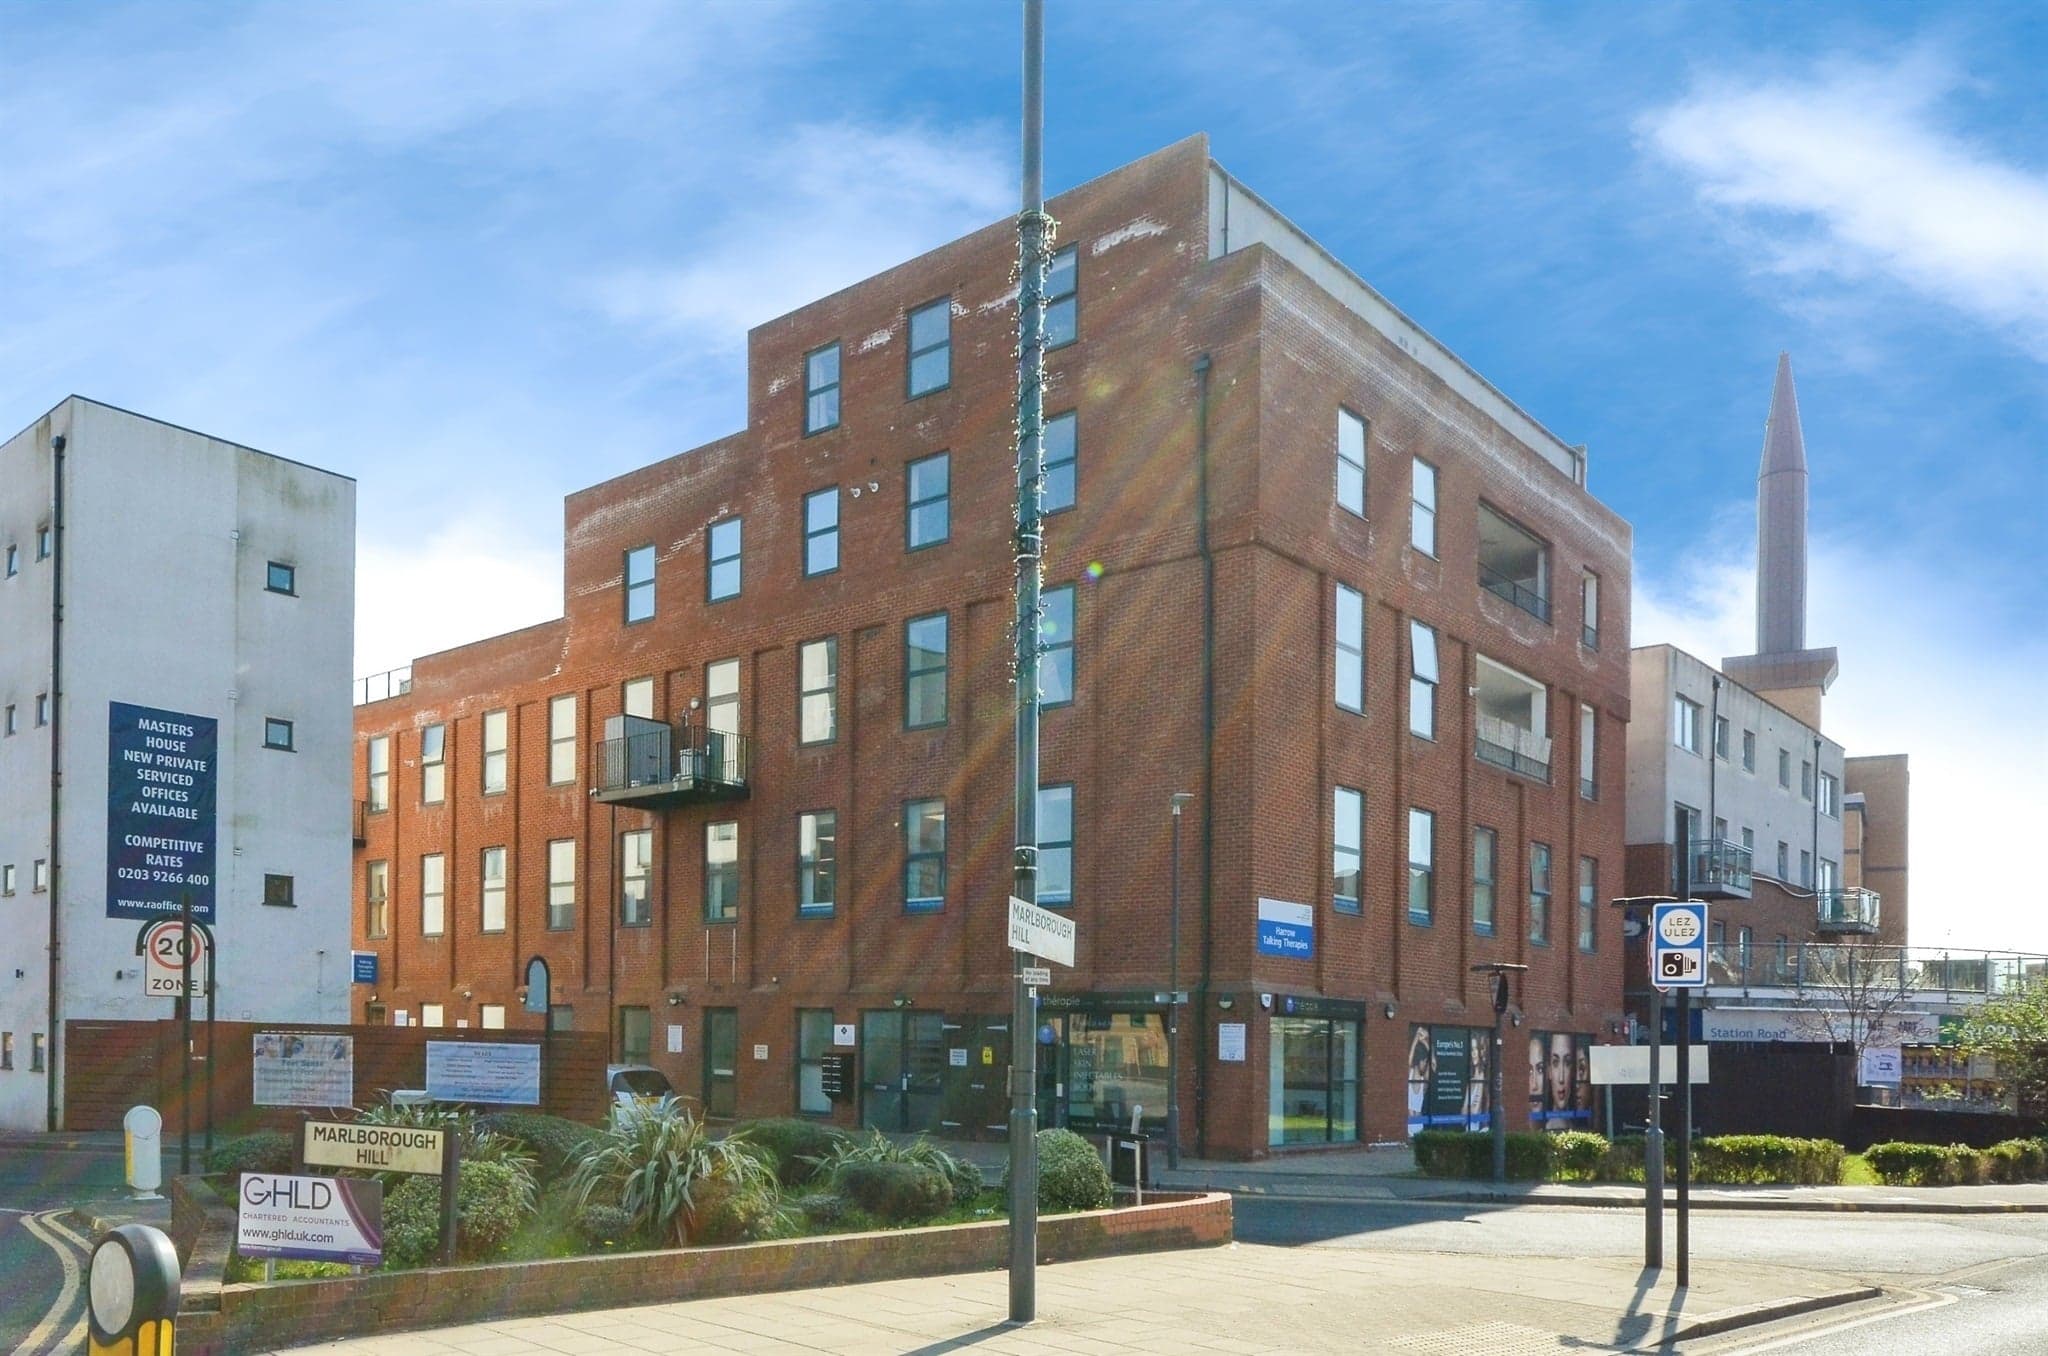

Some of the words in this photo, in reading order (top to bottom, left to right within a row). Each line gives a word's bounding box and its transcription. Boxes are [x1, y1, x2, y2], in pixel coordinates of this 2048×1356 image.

[138, 718, 194, 737] MASTERS
[146, 736, 187, 753] HOUSE
[124, 749, 153, 764] NEW
[156, 754, 207, 772] PRIVATE
[137, 768, 194, 786] SERVICED
[142, 786, 189, 802] OFFICES
[131, 801, 198, 820] AVAILABLE
[125, 834, 204, 853] COMPETITIVE
[146, 853, 183, 868] RATES
[118, 867, 149, 880] 0203
[153, 870, 184, 883] 9266
[187, 874, 209, 886] 400
[1012, 903, 1072, 940] MARLBOROUGH
[1669, 917, 1691, 927] LEZ
[1011, 924, 1030, 945] HILL
[1275, 926, 1296, 937] Harrow
[1664, 928, 1696, 937] ULEZ
[1263, 935, 1282, 949] Talking
[1283, 938, 1309, 951] Therapies
[1711, 1027, 1753, 1039] Station
[1757, 1028, 1787, 1040] Road
[313, 1126, 437, 1150] MARLBOROUGH
[356, 1148, 390, 1166] HILL
[243, 1176, 332, 1210] GHLD
[242, 1211, 288, 1223] CHARTERED
[292, 1215, 351, 1227] ACCOUNTANTS
[242, 1227, 334, 1244] www.ghld.uk.com
